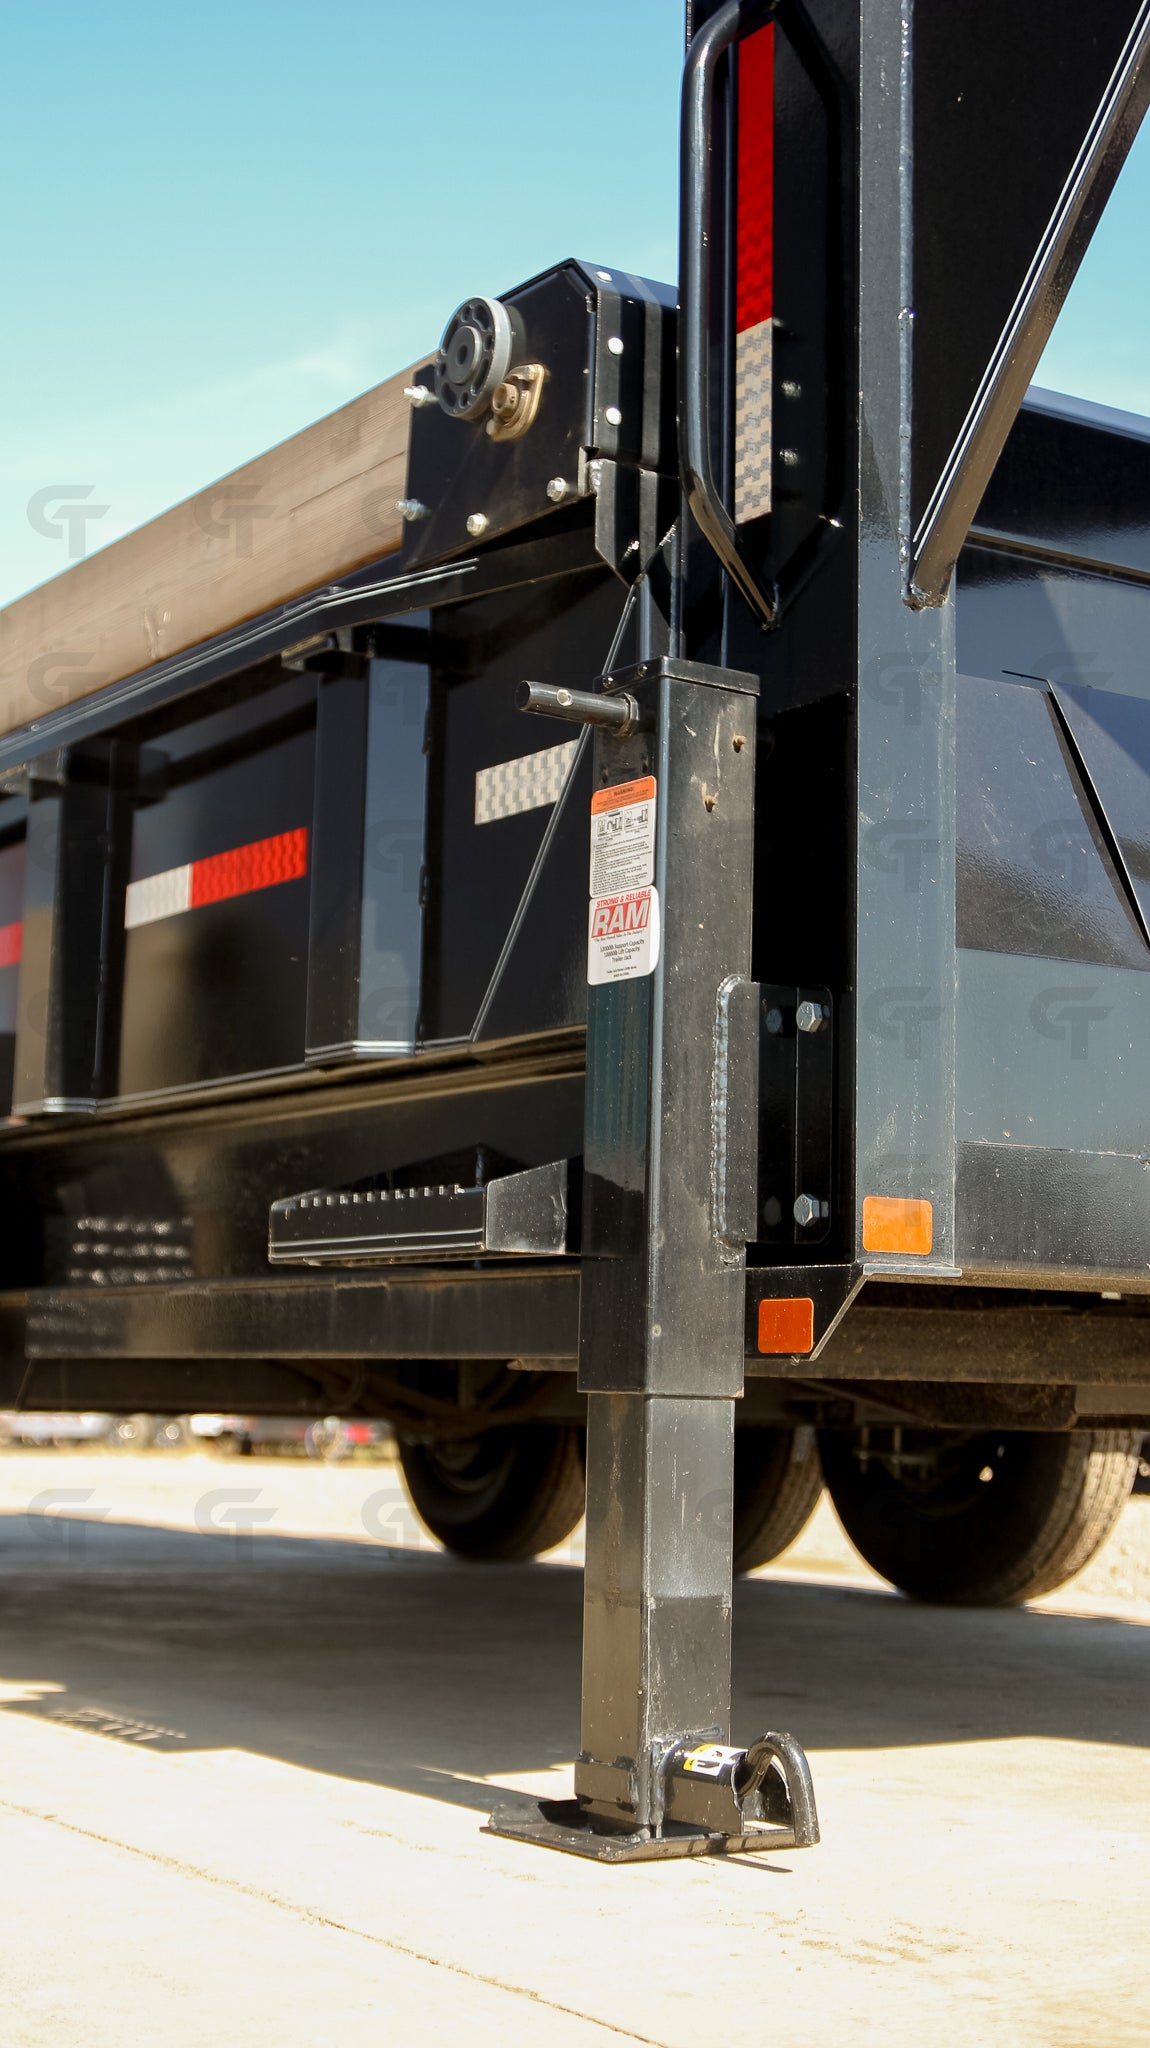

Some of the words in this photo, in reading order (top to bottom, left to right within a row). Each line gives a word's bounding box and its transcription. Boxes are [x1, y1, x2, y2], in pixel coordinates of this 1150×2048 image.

[596, 897, 619, 907] STRONG
[625, 890, 651, 901] RELIABLE
[593, 900, 649, 936] RAM
[614, 941, 629, 950] Support
[629, 939, 645, 947] Capacity
[625, 946, 640, 954] Capacity
